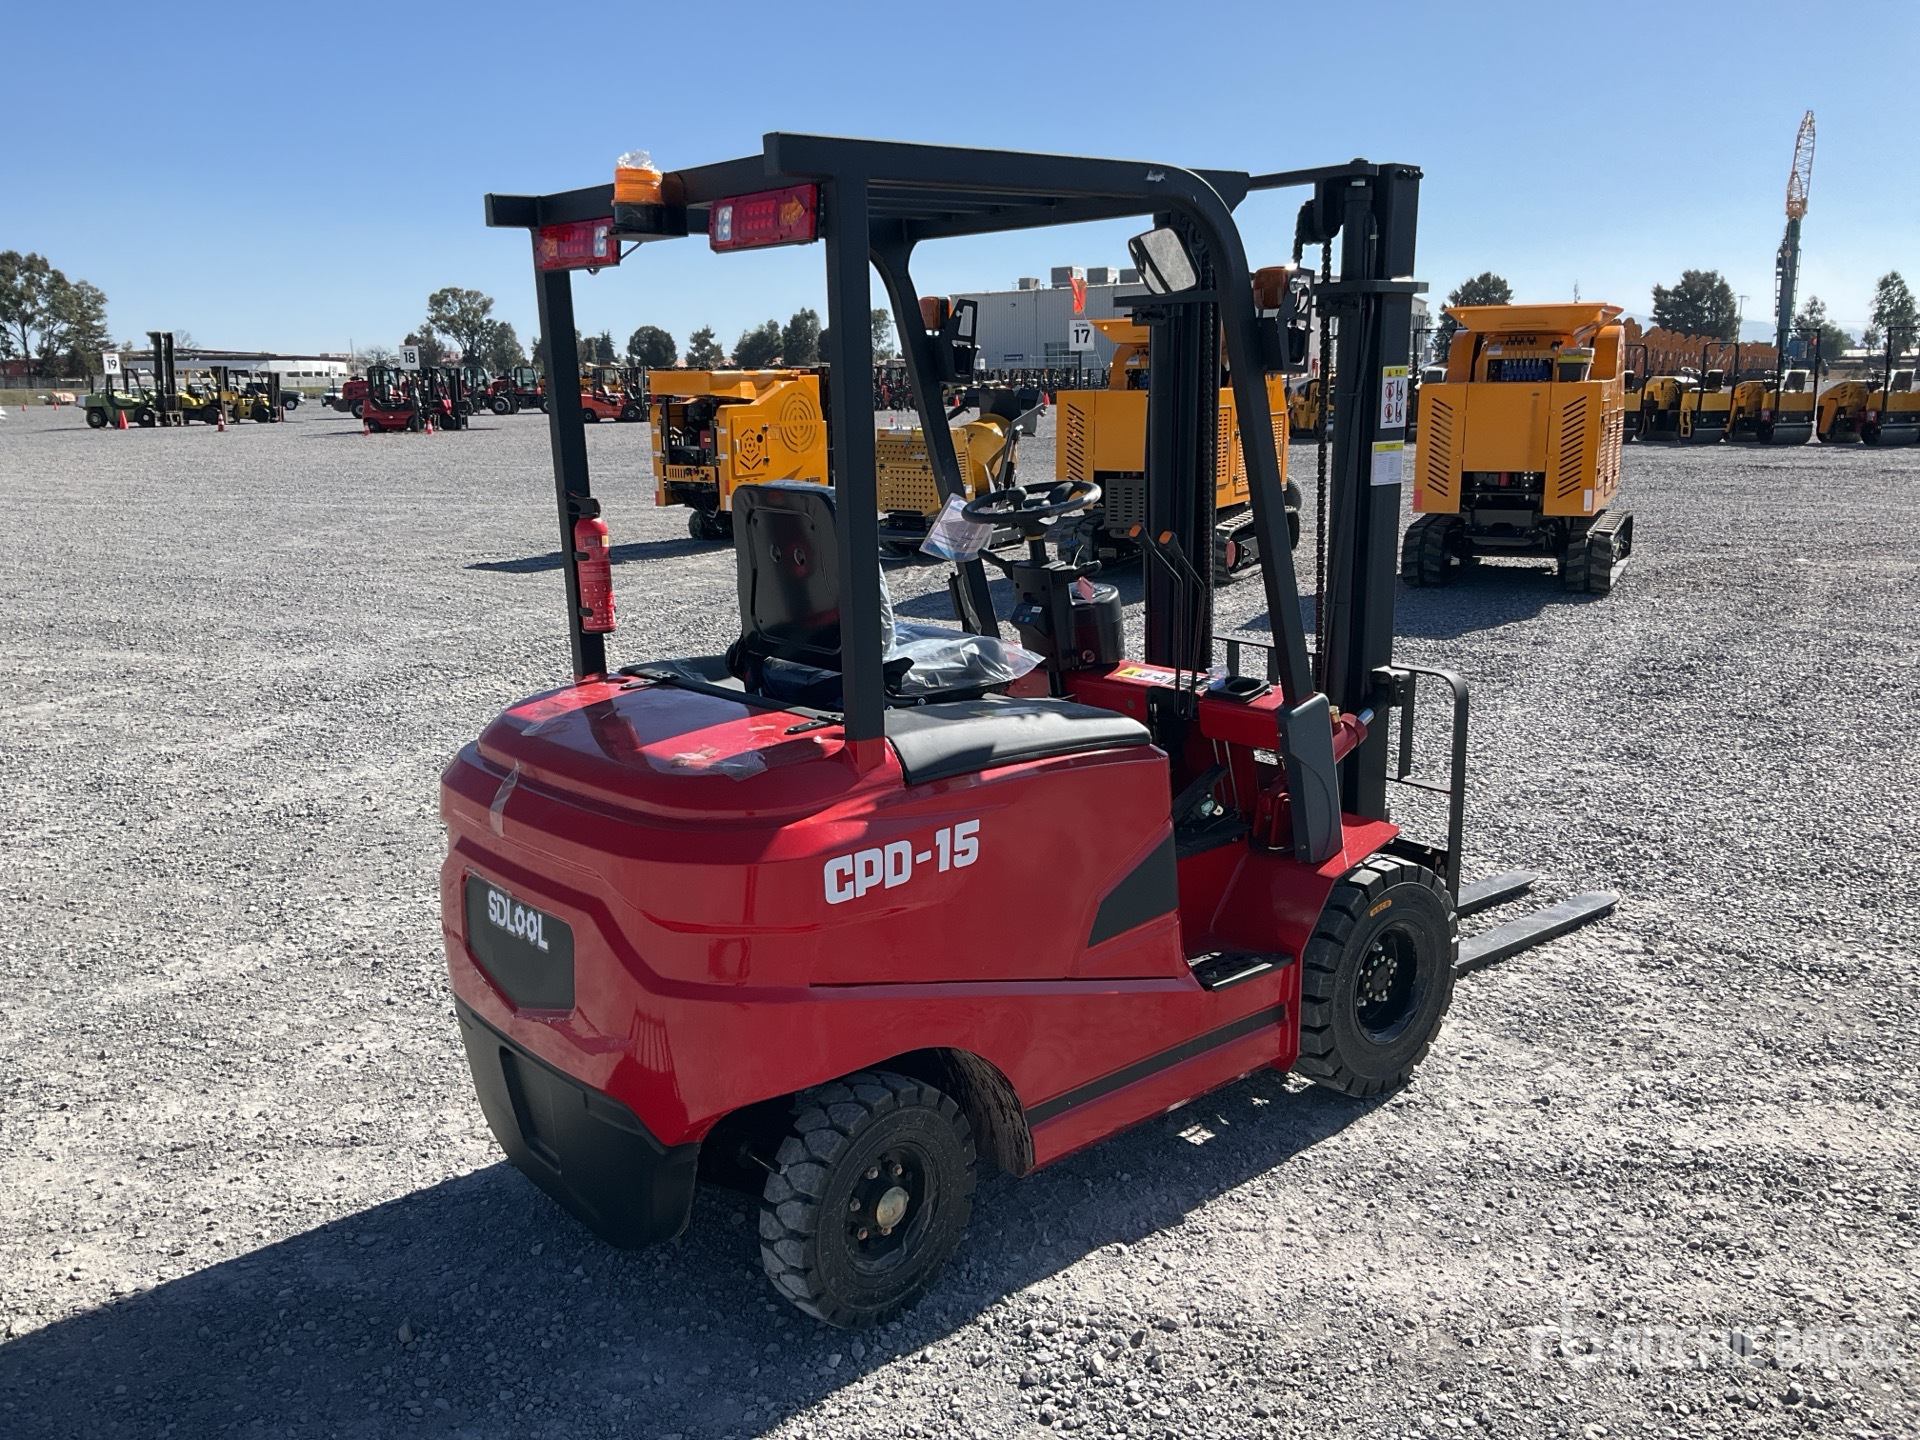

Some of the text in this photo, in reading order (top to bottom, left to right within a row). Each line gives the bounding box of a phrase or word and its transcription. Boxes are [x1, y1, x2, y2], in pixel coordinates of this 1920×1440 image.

[1073, 329, 1091, 344] 17
[106, 359, 117, 370] 19
[403, 351, 416, 364] 18
[823, 818, 980, 905] CPD-15
[488, 889, 548, 950] SDLOOL
